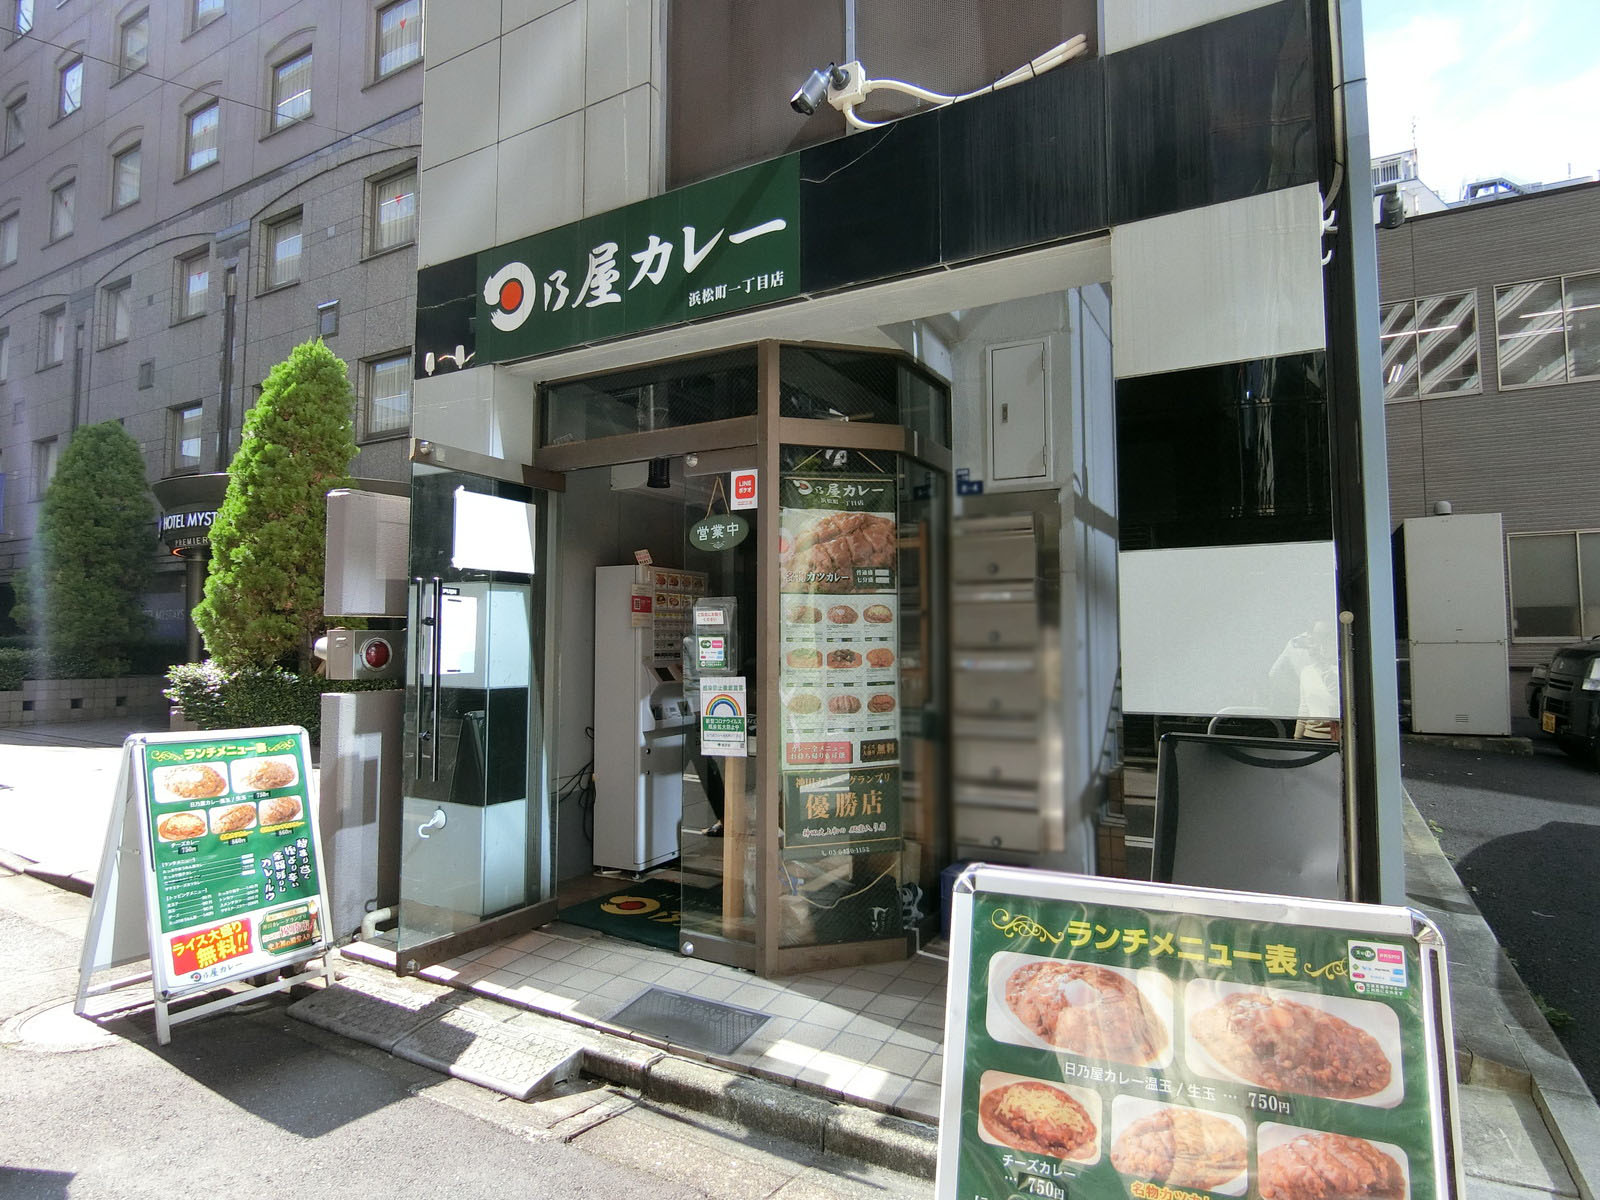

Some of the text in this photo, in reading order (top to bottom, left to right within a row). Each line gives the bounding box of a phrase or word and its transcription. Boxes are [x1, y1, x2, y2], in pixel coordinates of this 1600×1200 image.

[688, 270, 784, 308] 浜松町一丁目店
[163, 514, 185, 530] HOTEL
[696, 522, 739, 541] 営業中
[805, 789, 883, 820] 優勝店
[261, 858, 276, 901] カレールウ
[172, 920, 243, 957] ライス大盛り
[1066, 920, 1299, 977] ランチメニュー表
[1247, 1091, 1290, 1115] 750円
[1002, 1153, 1077, 1179] チーズカレー
[1027, 1177, 1065, 1200] 750円
